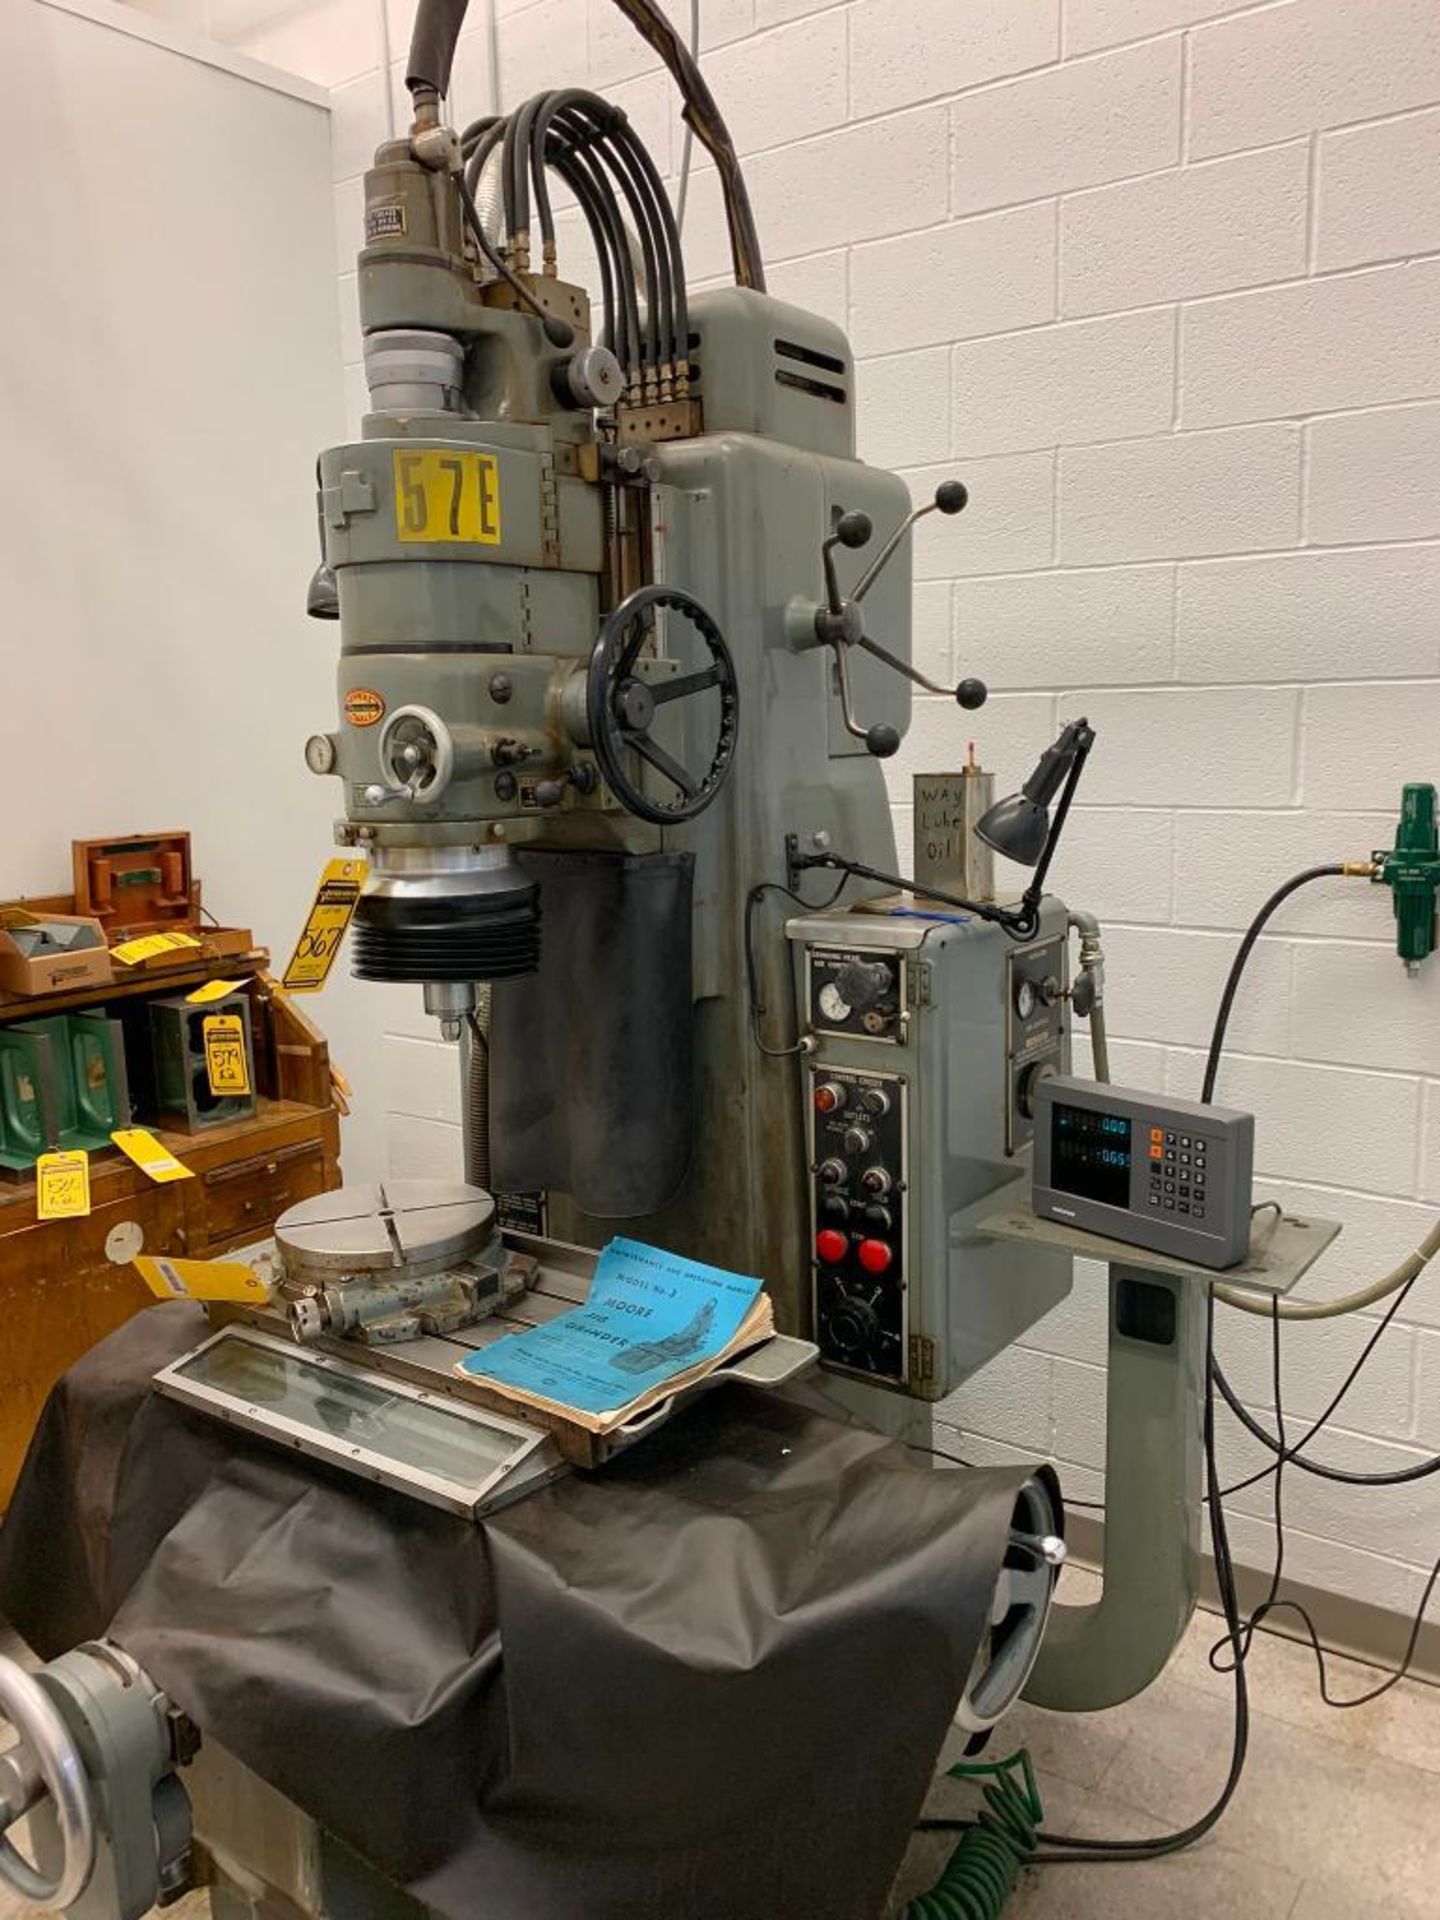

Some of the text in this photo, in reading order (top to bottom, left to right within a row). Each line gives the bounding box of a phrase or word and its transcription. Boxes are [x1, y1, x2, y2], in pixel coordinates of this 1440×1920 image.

[927, 839, 951, 860] Oil
[297, 926, 345, 959] 567
[616, 1272, 649, 1290] MODEL
[603, 1297, 654, 1318] MOORE
[564, 1321, 629, 1348] GRINDER
